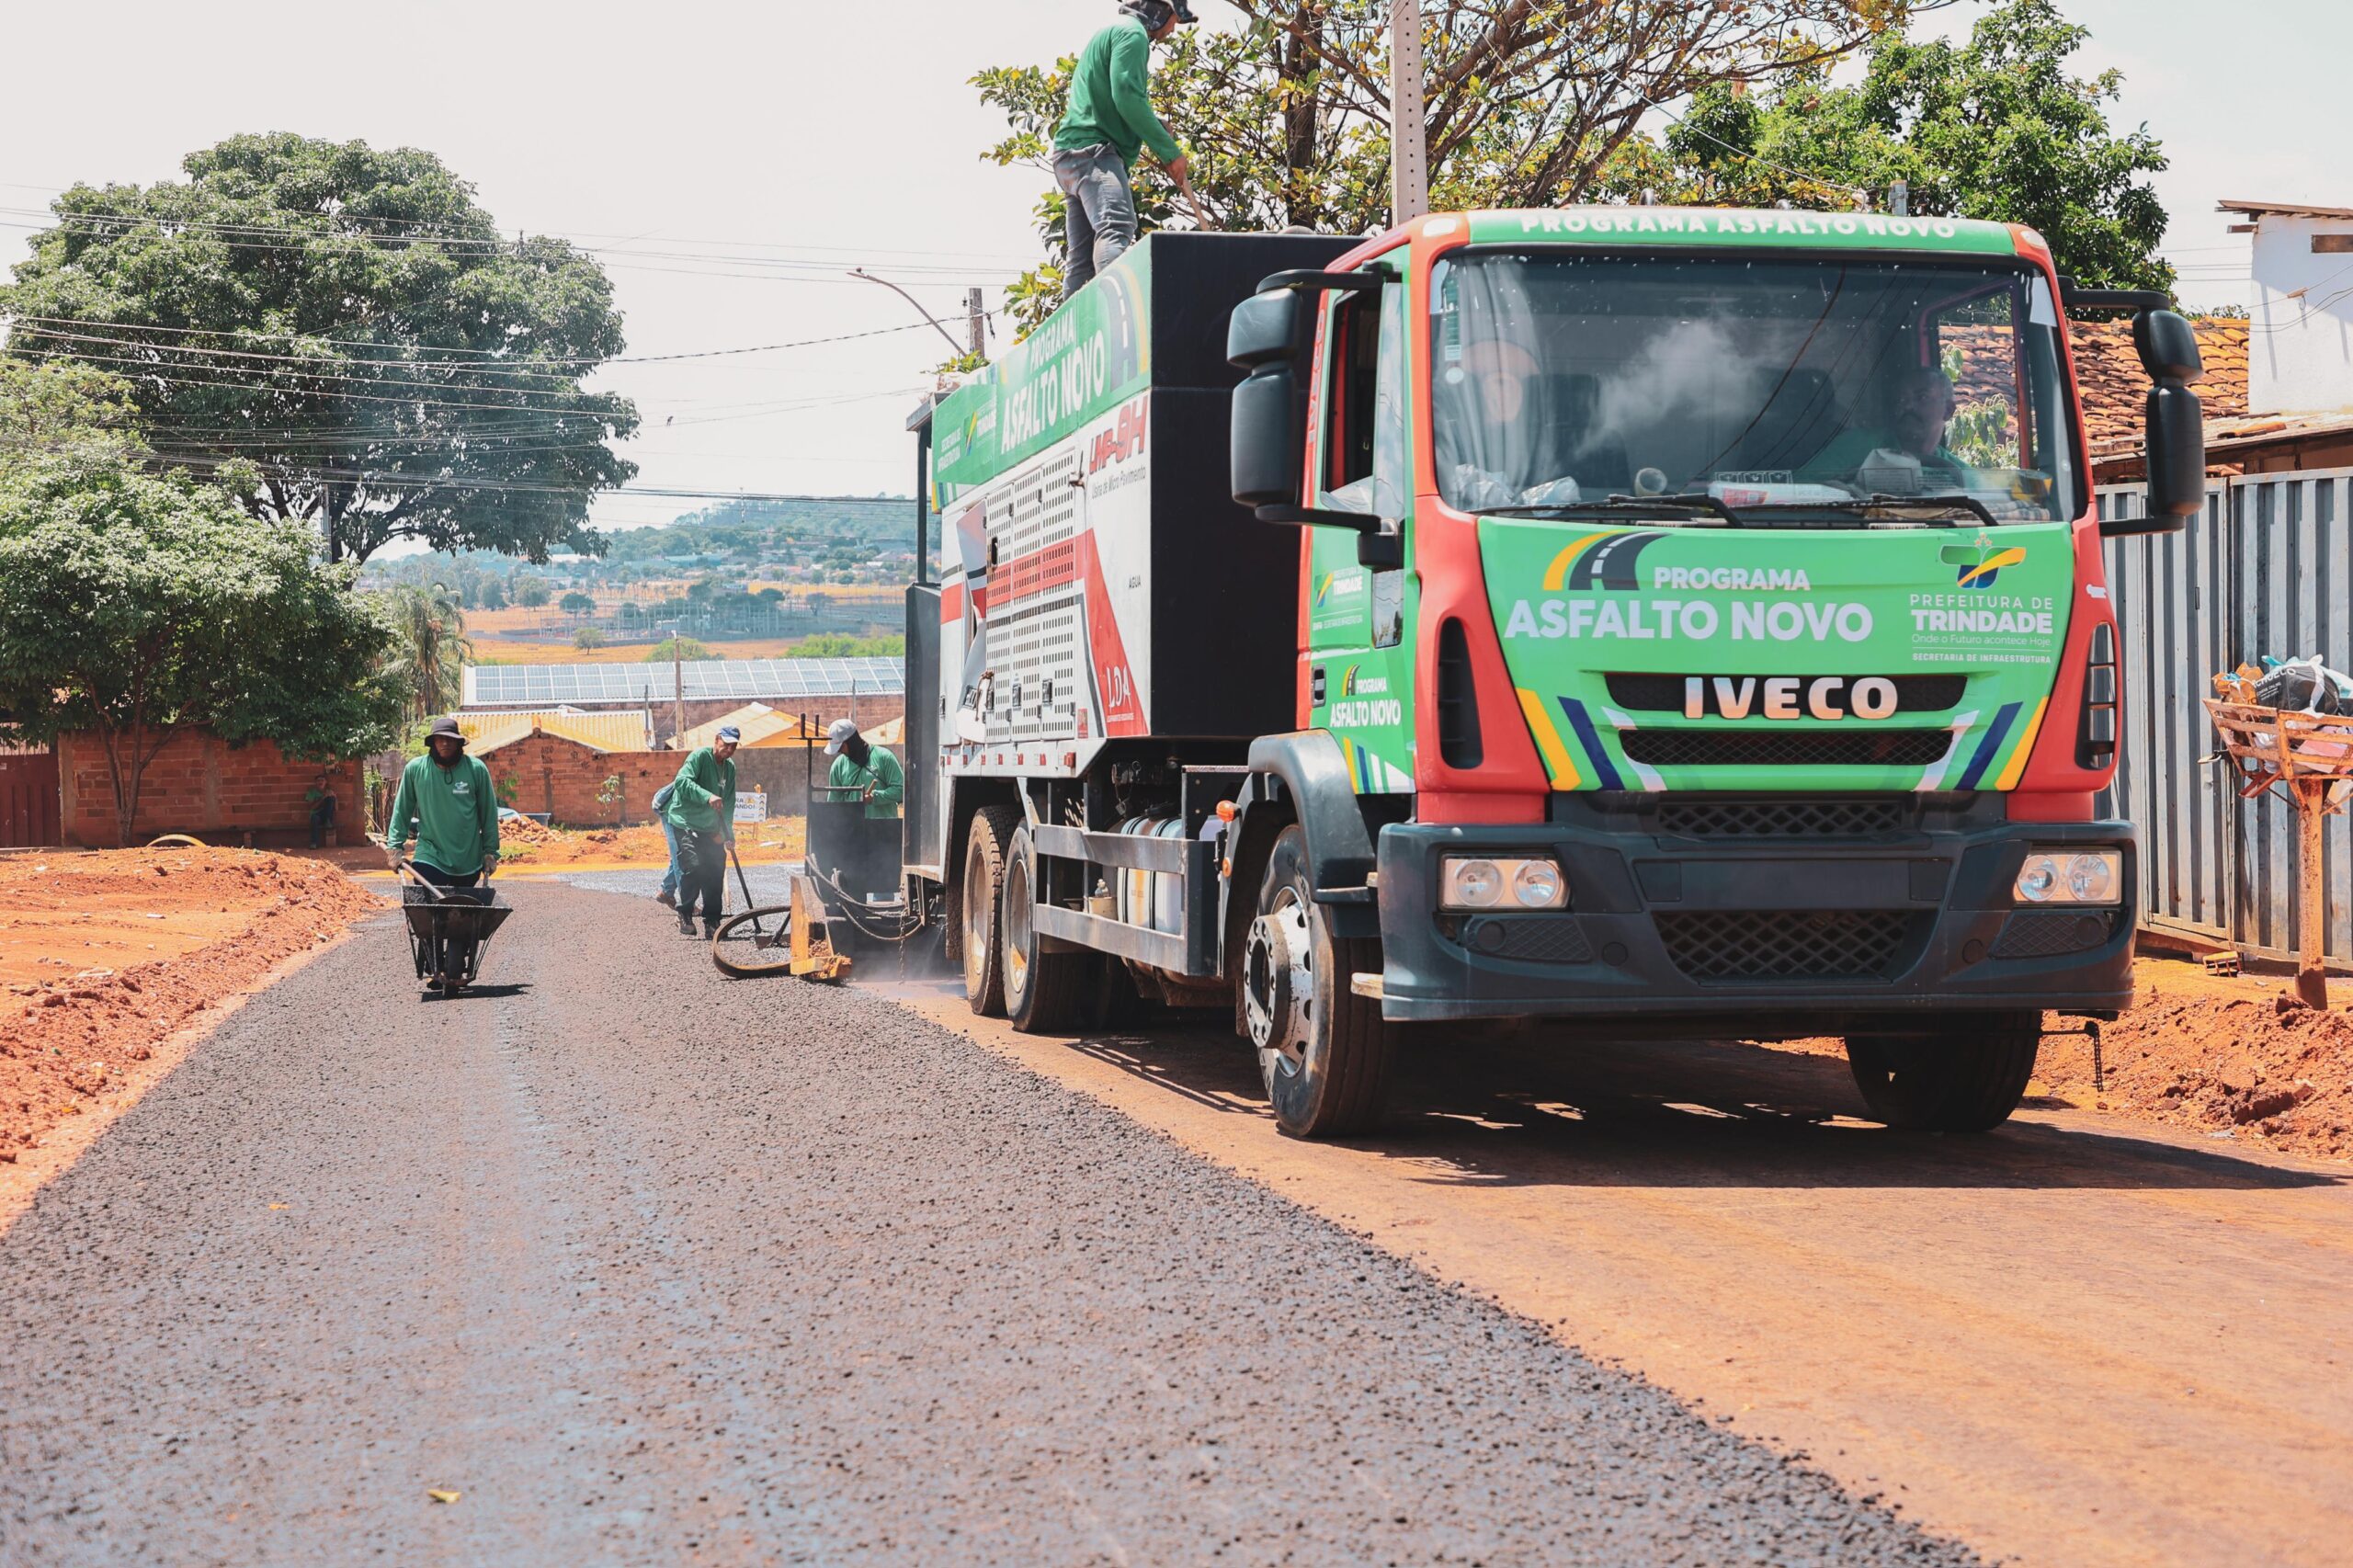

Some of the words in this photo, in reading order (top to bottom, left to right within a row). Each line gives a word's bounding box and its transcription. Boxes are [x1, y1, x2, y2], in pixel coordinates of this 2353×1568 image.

[1521, 215, 1708, 233] PROGRAMA
[1717, 216, 1857, 235] ASFALTO
[1866, 218, 1956, 238] NOVO
[1030, 308, 1074, 373] PROGRAMA
[1001, 363, 1058, 454] ASFALTO
[1062, 329, 1105, 419] NOVO
[1654, 566, 1811, 591] PROGRAMA
[1910, 594, 2023, 608] PREFEITURA
[2031, 597, 2053, 609] DE
[1503, 599, 1719, 640] ASFALTO
[1732, 601, 1873, 642] NOVO
[1911, 609, 2053, 634] TRINDADE
[1912, 633, 1939, 643] Onde
[1950, 634, 1982, 644] Futuro
[1984, 636, 2027, 645] acontece
[1913, 653, 1964, 662] SECRETARIA
[1966, 653, 1977, 662] DE
[1980, 653, 2051, 664] INFRAESTRUTURA
[1107, 665, 1132, 713] LDA
[1356, 676, 1387, 694] PROGRAMA
[1684, 676, 1898, 720] IVECO
[1329, 700, 1370, 728] ASFALTO
[1370, 699, 1402, 726] NOVO
